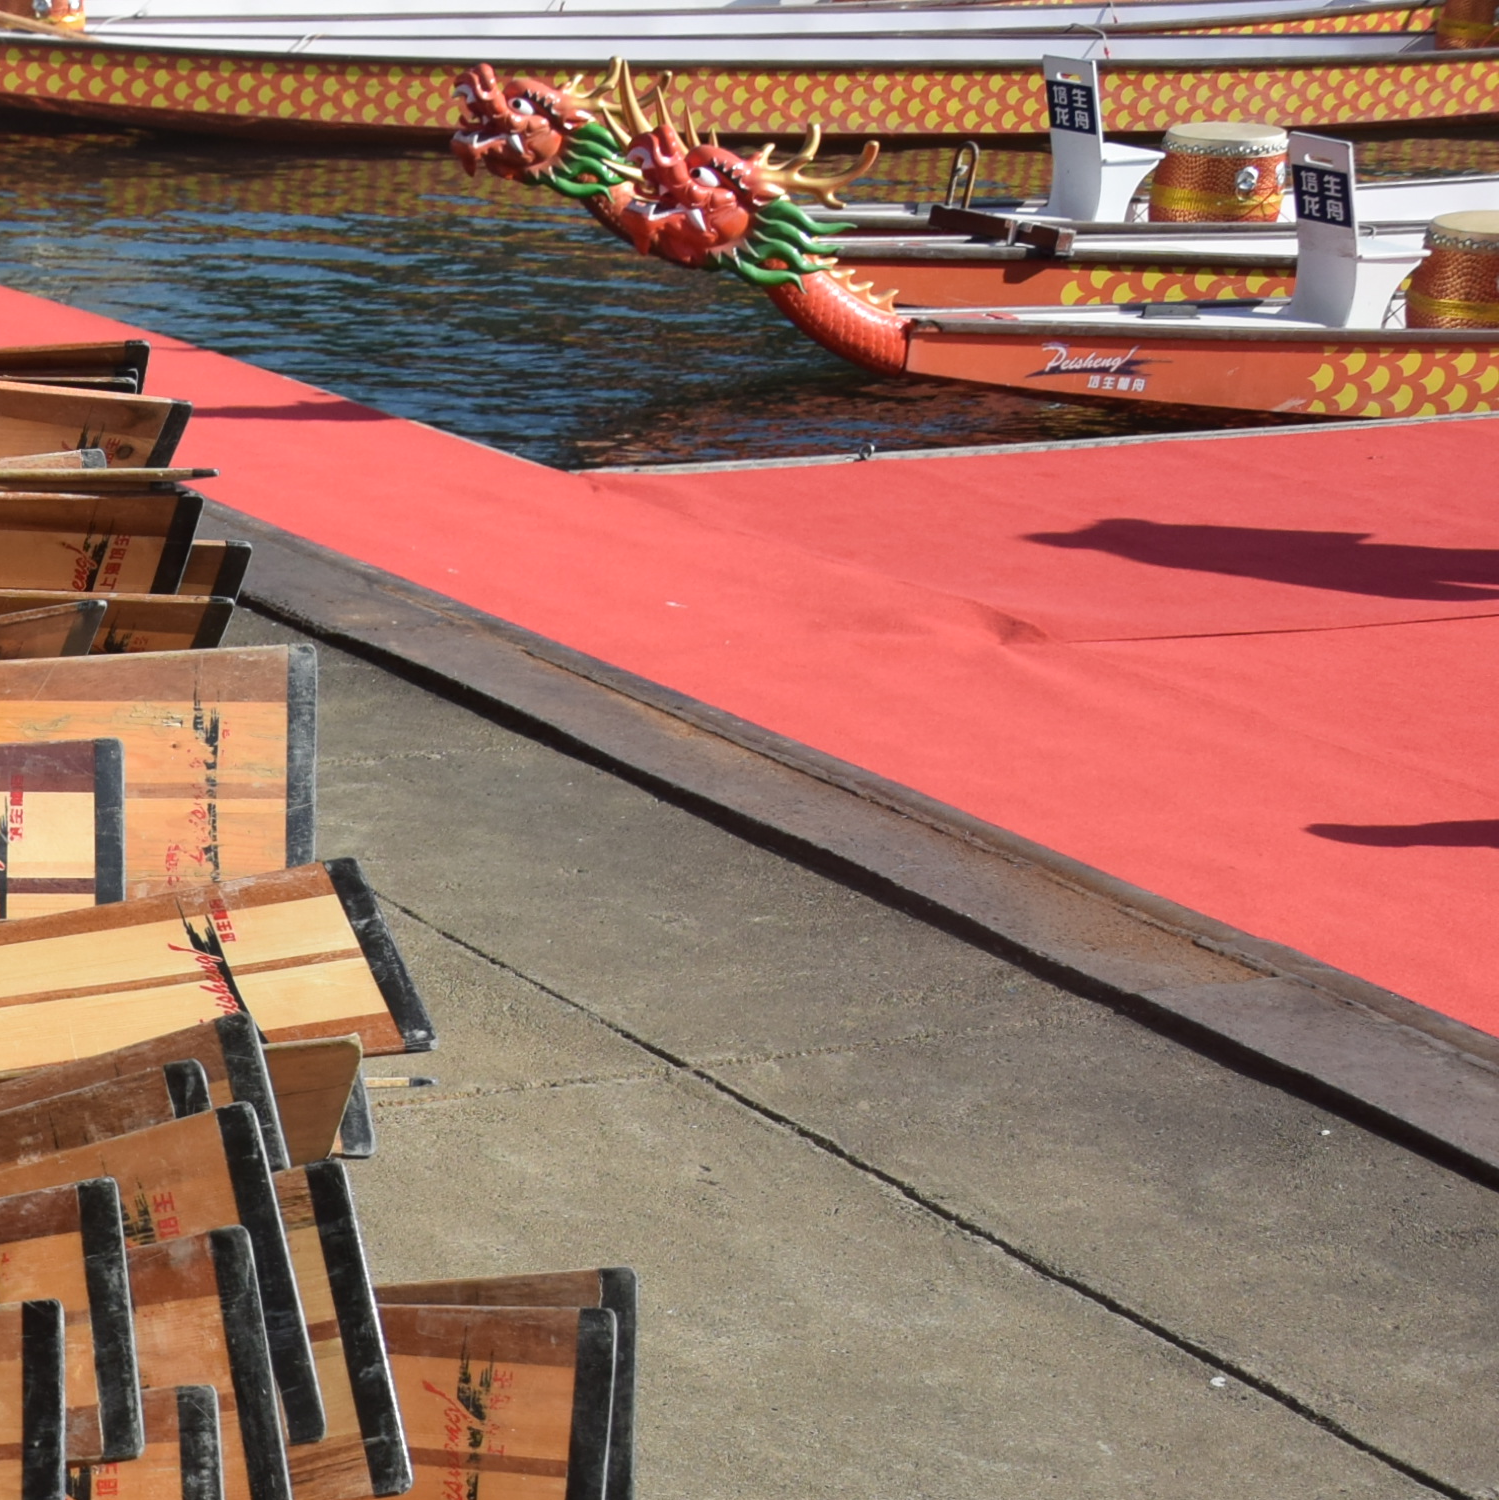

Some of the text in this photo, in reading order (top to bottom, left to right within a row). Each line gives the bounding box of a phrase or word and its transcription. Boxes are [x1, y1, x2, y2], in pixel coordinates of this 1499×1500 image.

[1052, 85, 1088, 108] 培生
[1054, 106, 1091, 130] 龙舟
[1299, 169, 1343, 198] 培生
[1302, 193, 1345, 221] 龙舟
[1041, 341, 1141, 373] Peisheng
[167, 942, 241, 1016] eisheng
